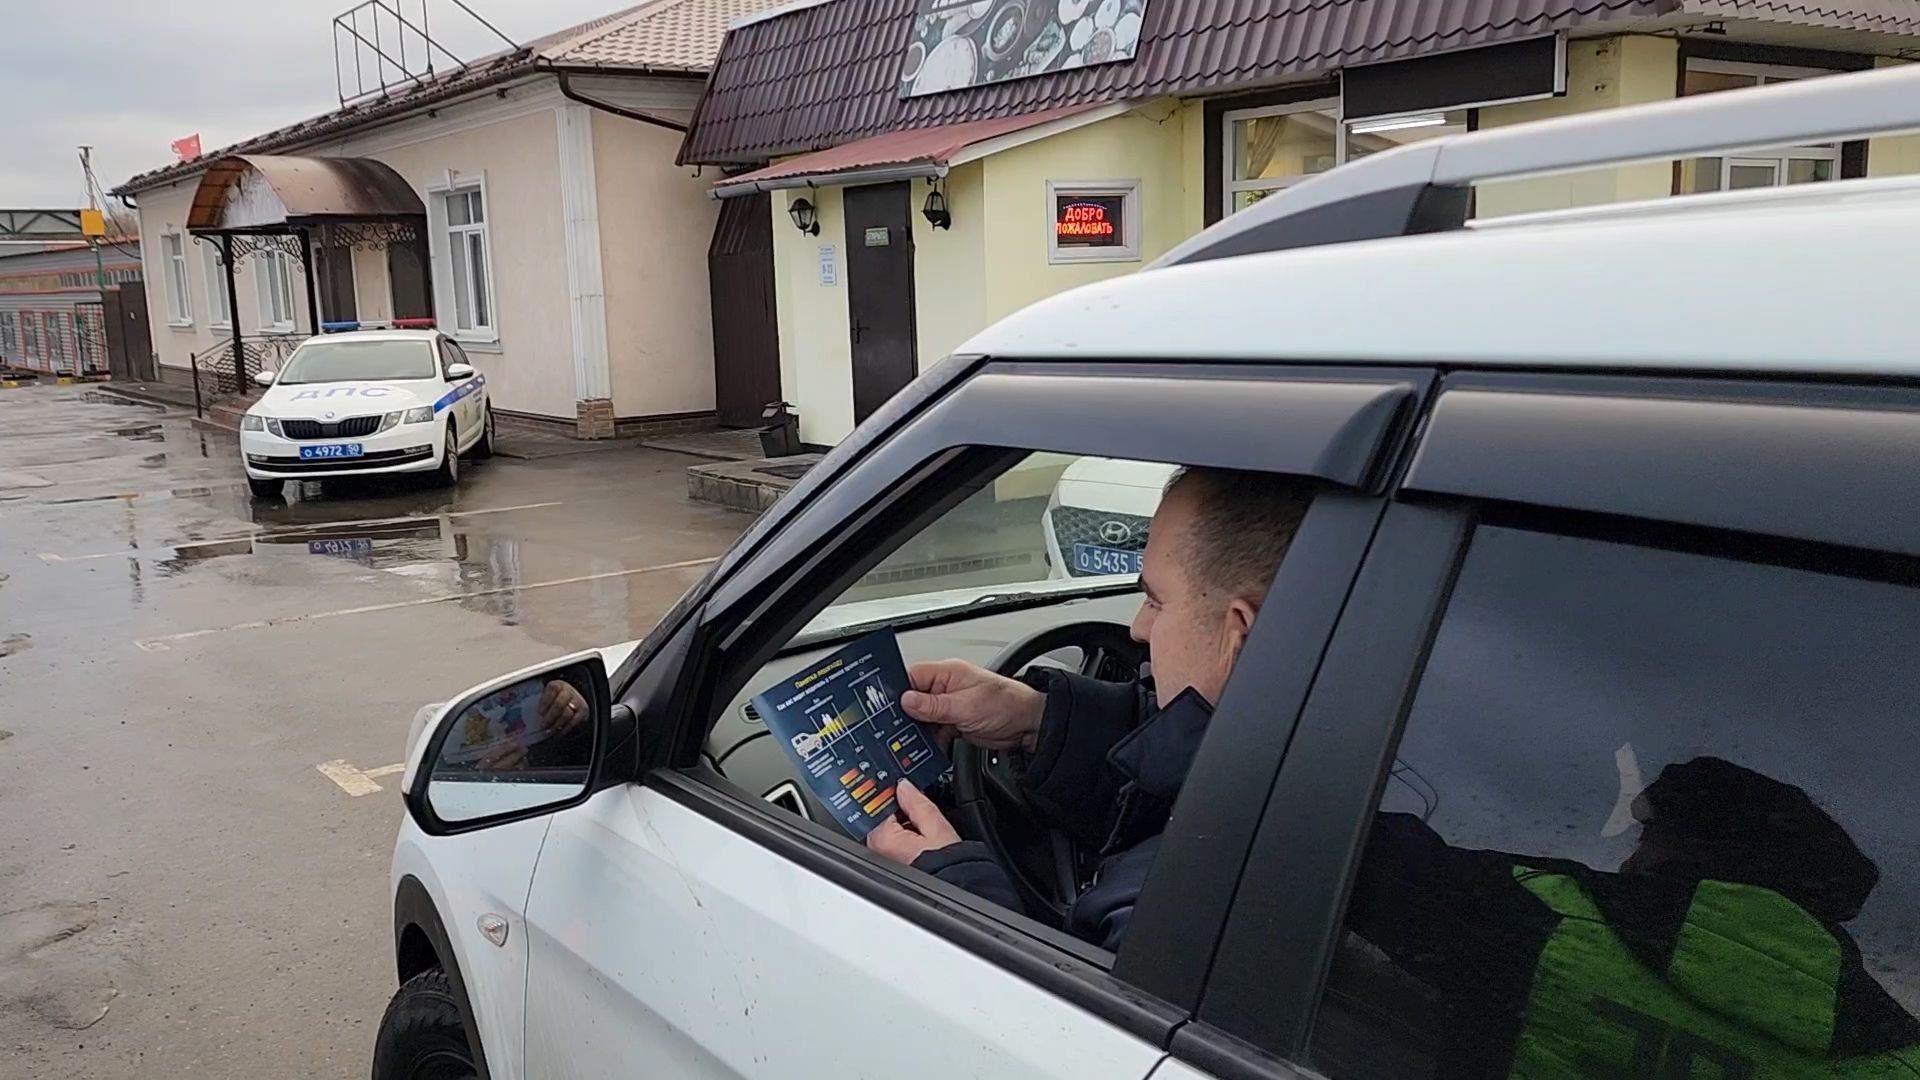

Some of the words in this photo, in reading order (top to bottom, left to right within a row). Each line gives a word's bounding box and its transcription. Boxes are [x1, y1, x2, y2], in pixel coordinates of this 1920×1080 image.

[1065, 207, 1104, 222] ДОБРО
[1056, 221, 1113, 235] ПОЖАЛОВАТЬ
[290, 387, 390, 401] ДПС
[315, 445, 342, 457] 4972
[348, 444, 360, 453] 50
[1093, 549, 1129, 574] 5435
